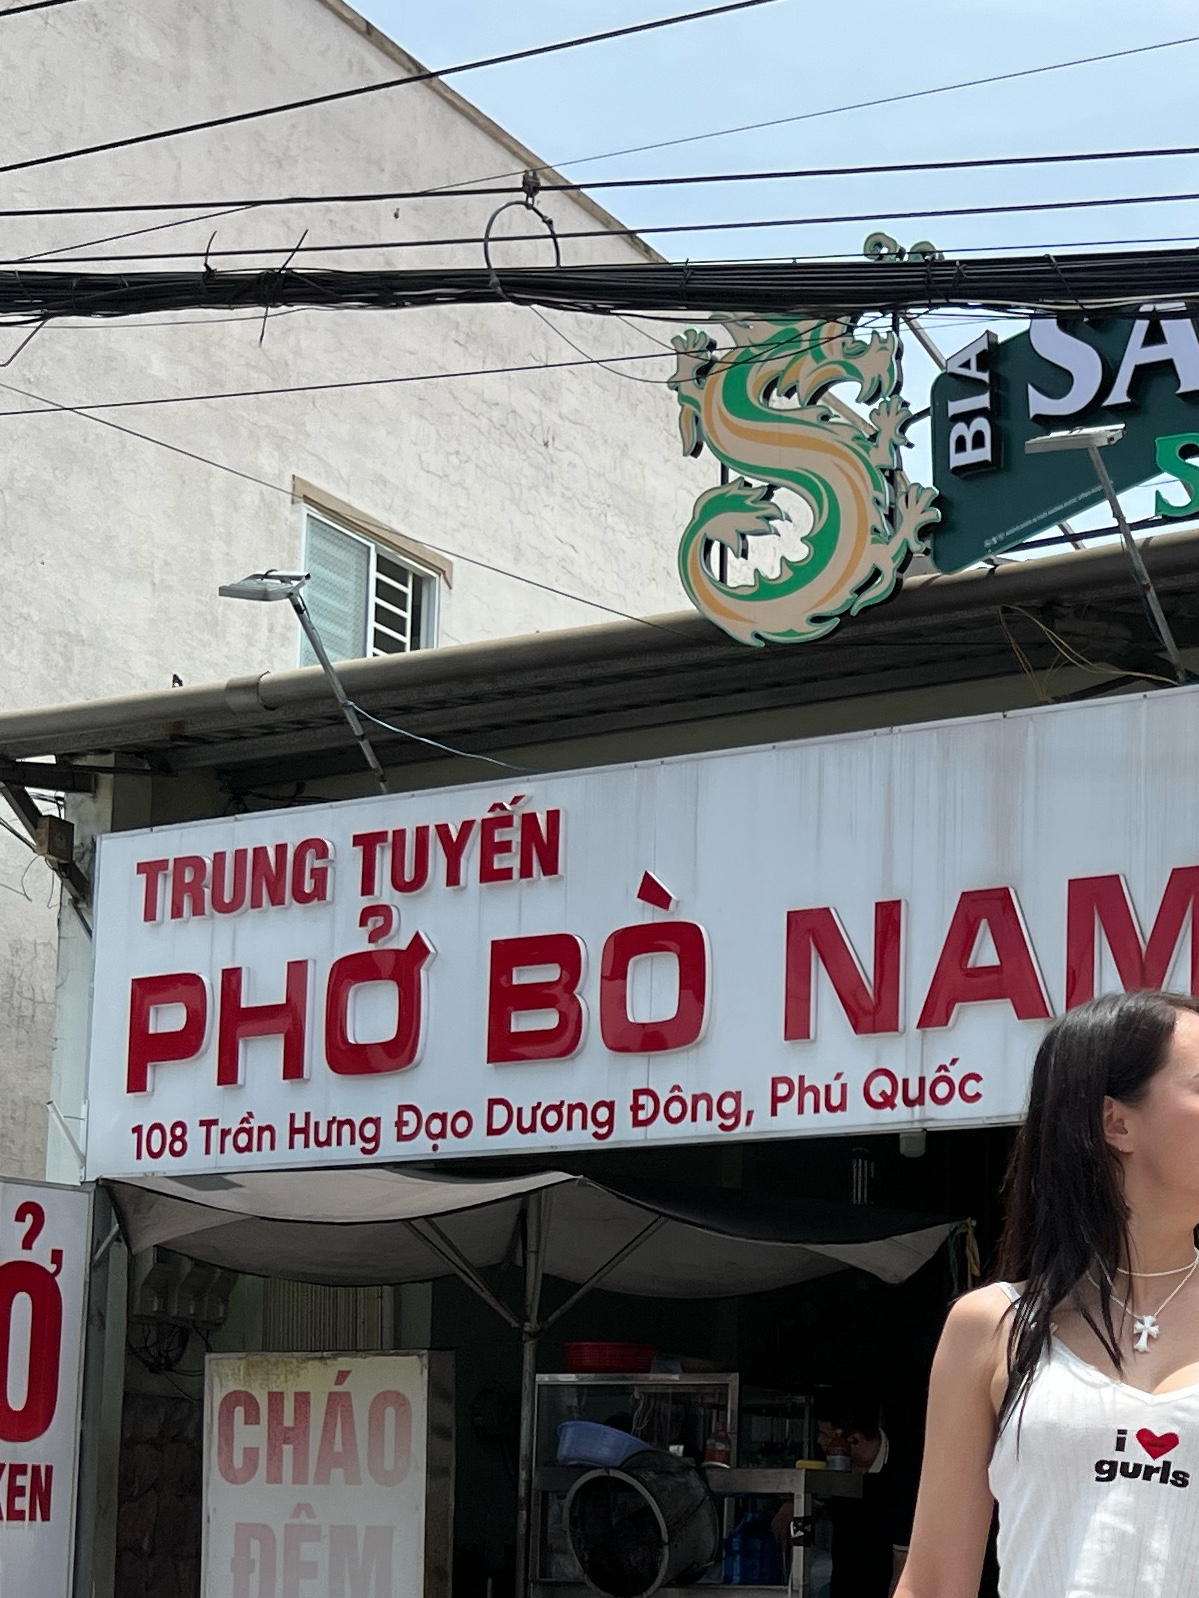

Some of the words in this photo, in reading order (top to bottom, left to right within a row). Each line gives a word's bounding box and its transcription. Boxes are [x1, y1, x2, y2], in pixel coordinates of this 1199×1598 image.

[947, 330, 997, 474] BIA
[136, 837, 331, 923] TRUNG
[352, 794, 562, 898] TUYẾN
[126, 904, 436, 1095] PHỞ
[486, 870, 709, 1065] BÒ
[131, 1122, 189, 1160] 108
[198, 1111, 276, 1155] Trần
[288, 1109, 382, 1154] Hưng
[395, 1104, 473, 1152] Đạo
[486, 1097, 616, 1141] Dương
[630, 1087, 755, 1132] Đông,
[770, 1071, 848, 1118] Phú
[863, 1056, 984, 1112] Quốc
[217, 1369, 414, 1489] CHÁO
[1094, 1459, 1191, 1489] gurls
[1115, 1428, 1128, 1452] i
